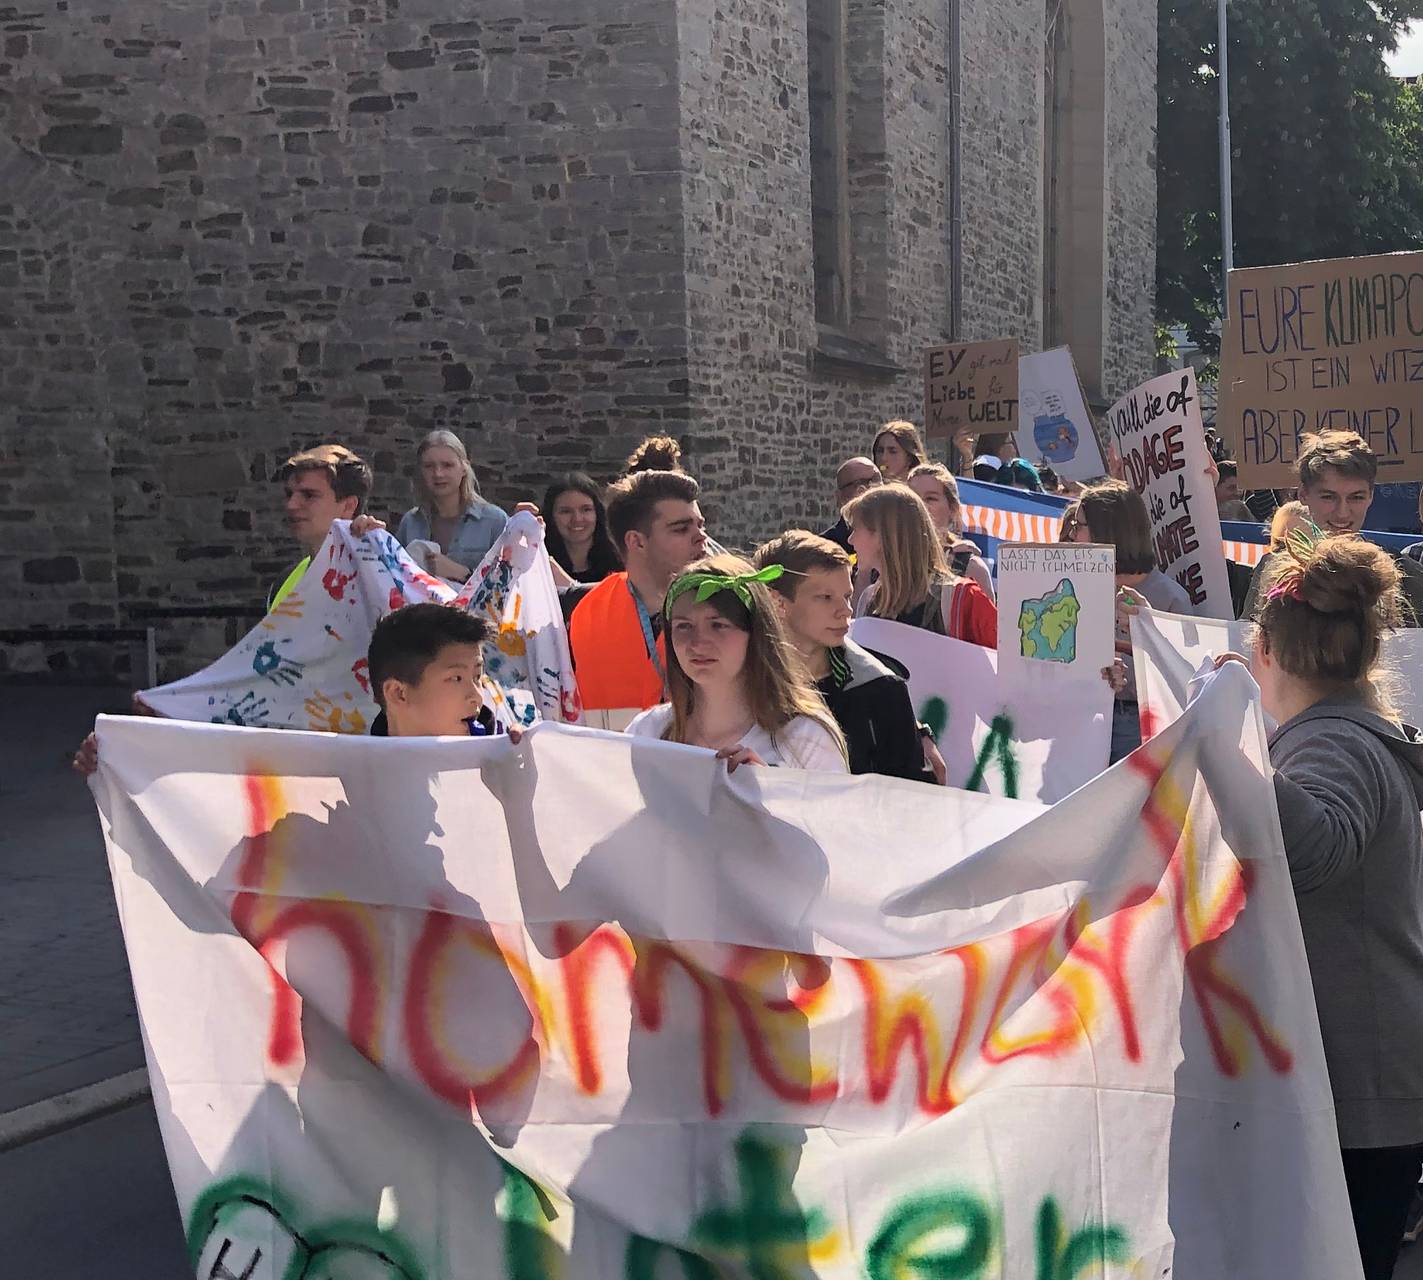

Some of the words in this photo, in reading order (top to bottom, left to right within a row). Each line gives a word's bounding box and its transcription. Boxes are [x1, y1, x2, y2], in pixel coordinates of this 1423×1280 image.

[1240, 285, 1315, 354] EURE
[930, 349, 967, 378] EY
[1266, 358, 1303, 392] IST
[1312, 356, 1350, 389] EIN
[930, 381, 976, 404] Liebe
[1144, 392, 1164, 422] die
[1167, 375, 1192, 416] of
[968, 400, 1018, 422] WELT
[1242, 408, 1306, 465] ABER
[1150, 491, 1166, 525] die
[1170, 474, 1192, 515] of
[1000, 560, 1036, 572] NICHT
[1042, 561, 1114, 572] SCHMELZEN
[1001, 548, 1038, 560] LASST
[1044, 550, 1067, 560] DAS
[1074, 549, 1094, 560] EIS
[231, 750, 1294, 1116] homework
